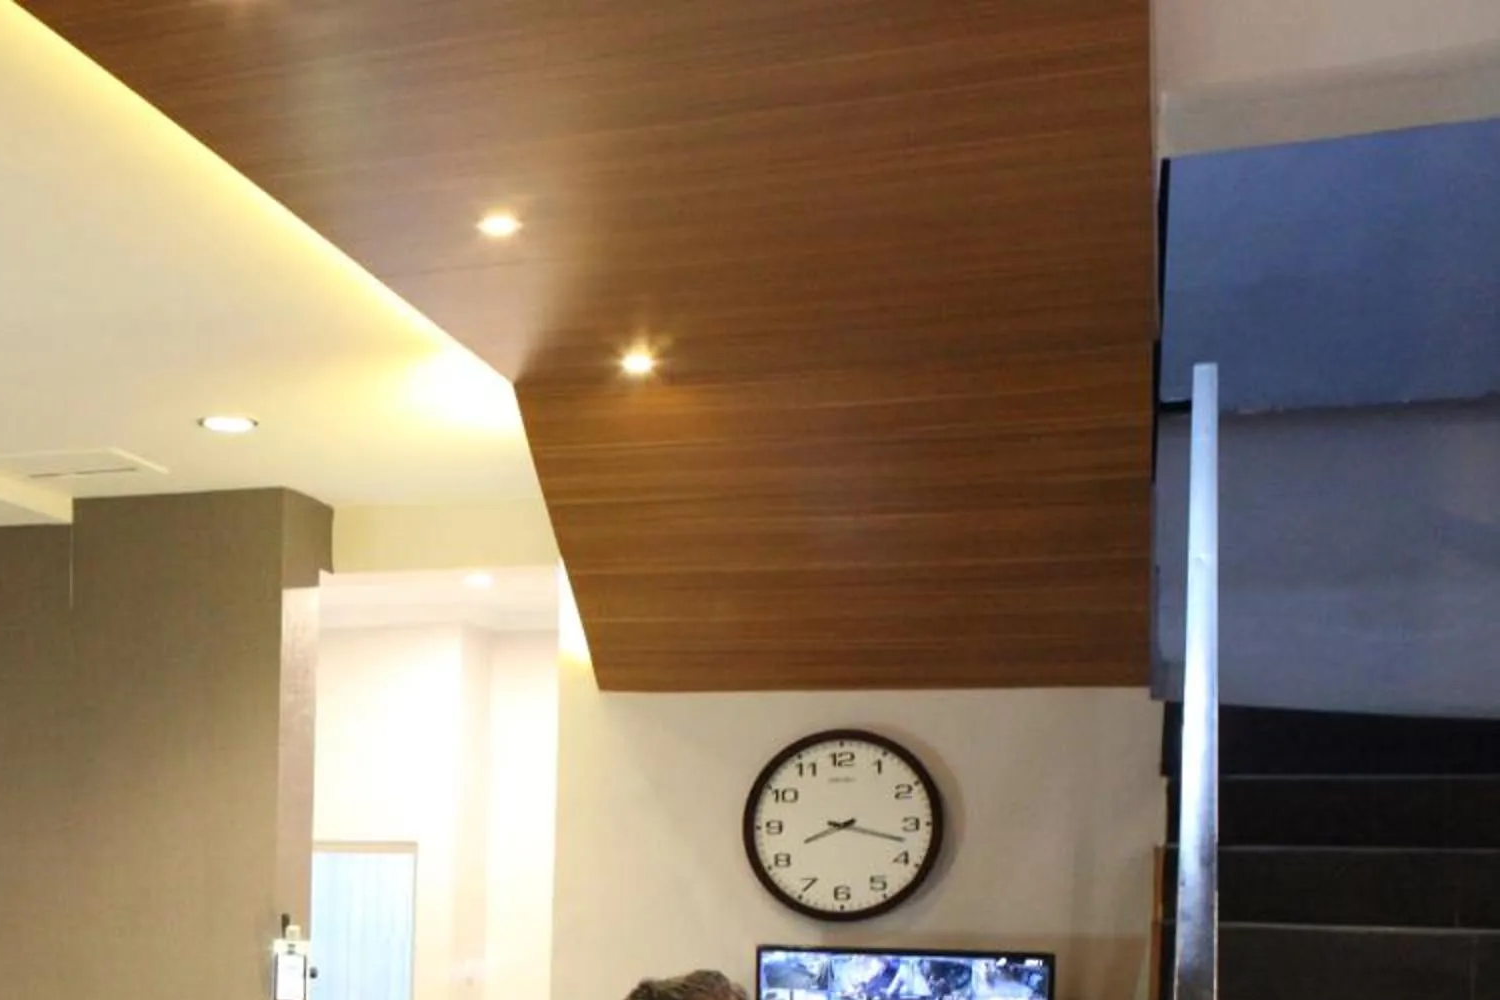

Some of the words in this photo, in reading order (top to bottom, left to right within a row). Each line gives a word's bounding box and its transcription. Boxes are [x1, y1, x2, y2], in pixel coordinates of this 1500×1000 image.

[829, 752, 856, 768] 12
[873, 759, 883, 774] 1
[796, 762, 818, 778] 11
[772, 788, 799, 804] 10
[894, 784, 913, 800] 2
[766, 820, 783, 836] 9
[902, 817, 920, 832] 3
[774, 853, 792, 868] 8
[893, 851, 910, 866] 4
[801, 877, 819, 893] 7
[869, 875, 888, 892] 5
[833, 885, 851, 902] 6
